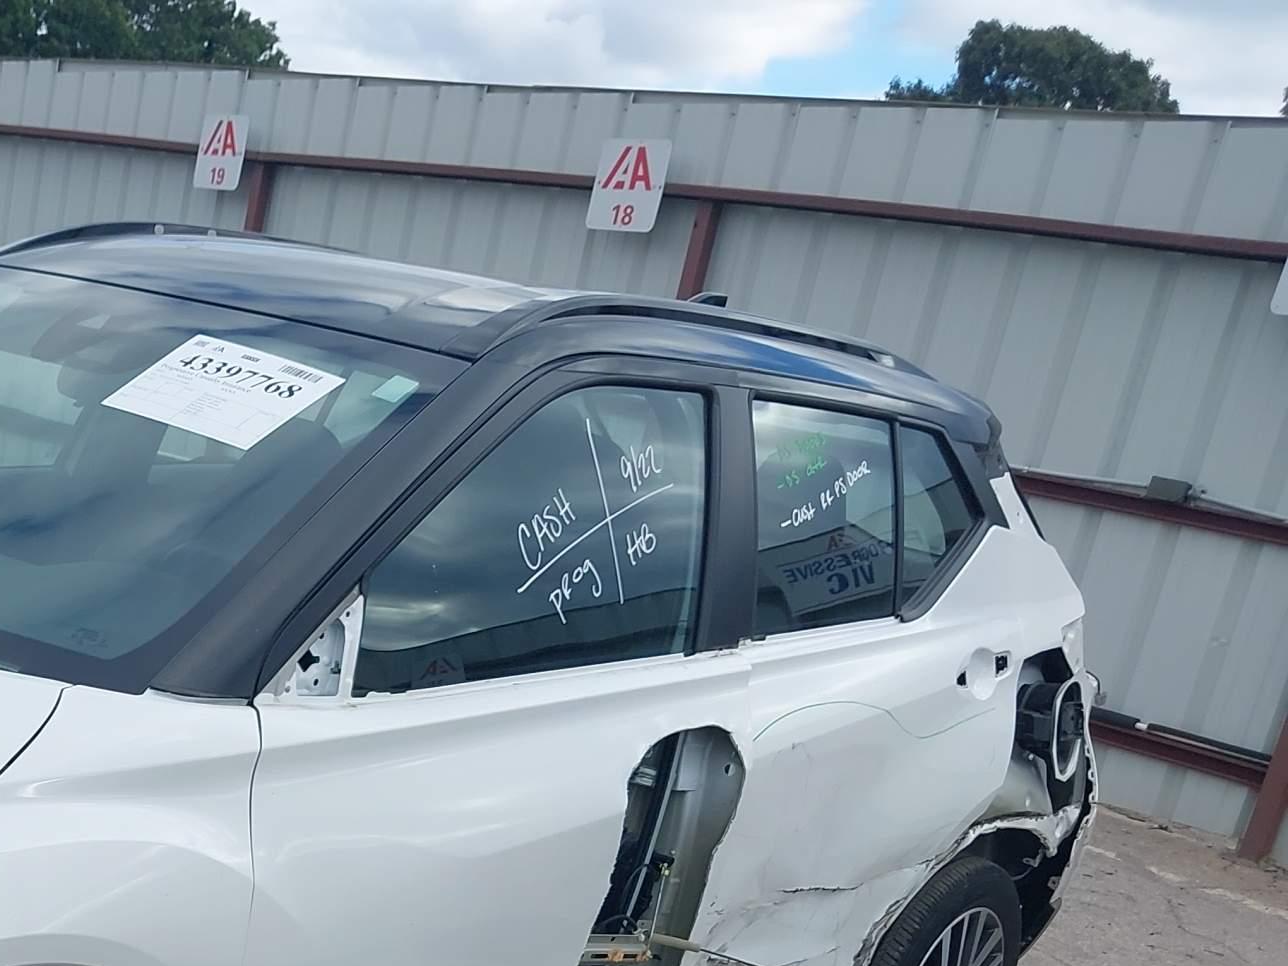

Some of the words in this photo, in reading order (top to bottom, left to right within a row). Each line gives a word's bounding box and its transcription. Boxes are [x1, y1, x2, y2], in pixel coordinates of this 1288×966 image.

[204, 120, 236, 156] IAA
[211, 167, 225, 185] 19
[601, 146, 651, 191] IAA
[612, 204, 634, 226] 18
[179, 354, 303, 399] 43397768
[620, 445, 662, 493] 9/22
[834, 477, 847, 498] PS
[846, 460, 871, 488] DOOR
[518, 488, 576, 570] CASH
[626, 522, 657, 566] HB
